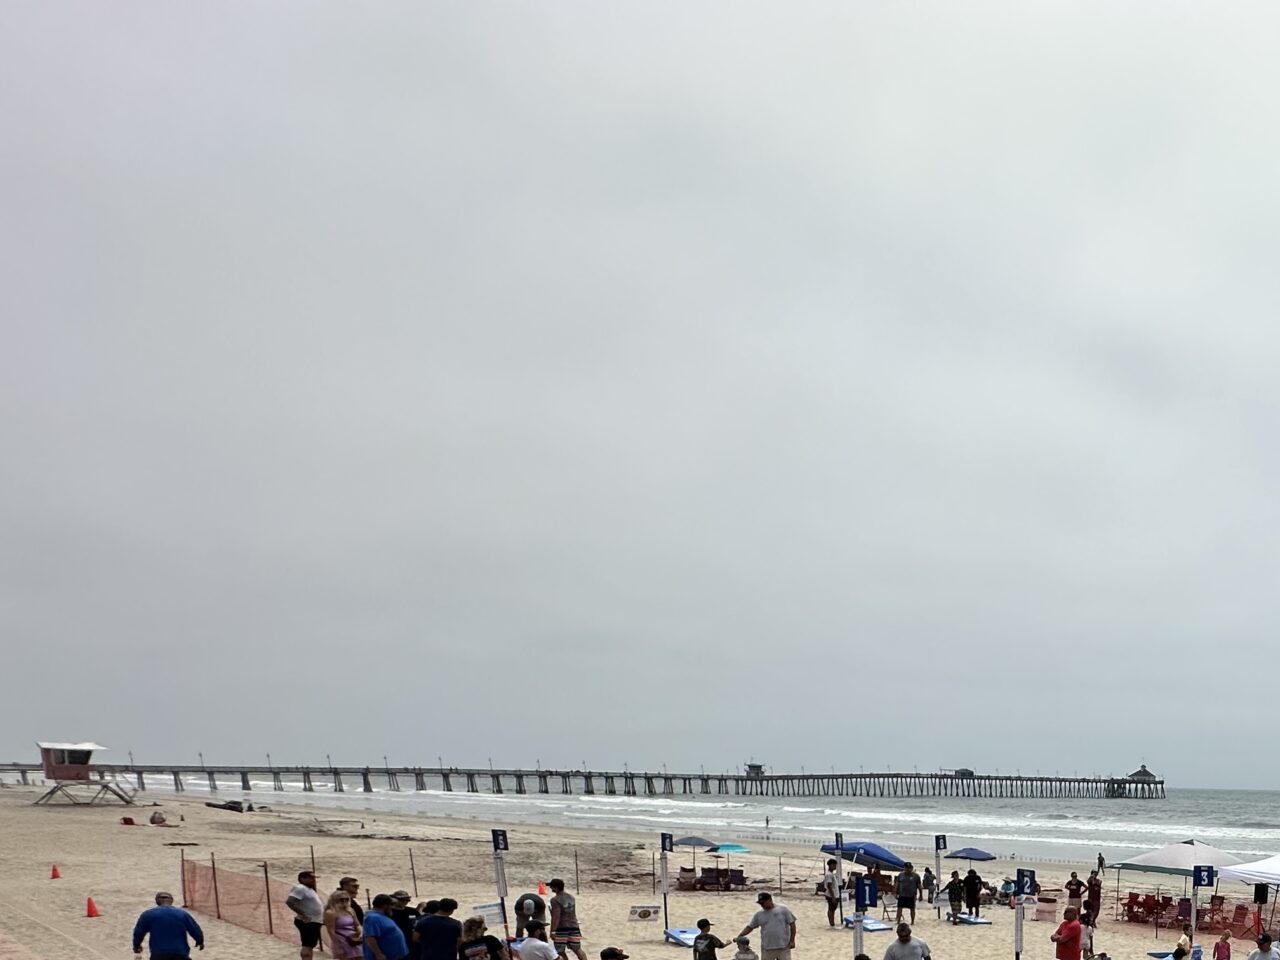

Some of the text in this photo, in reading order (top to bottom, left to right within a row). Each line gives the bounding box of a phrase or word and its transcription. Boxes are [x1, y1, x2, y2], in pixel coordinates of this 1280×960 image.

[1023, 876, 1031, 894] 2
[1201, 871, 1208, 885] 3
[864, 885, 871, 905] 1
